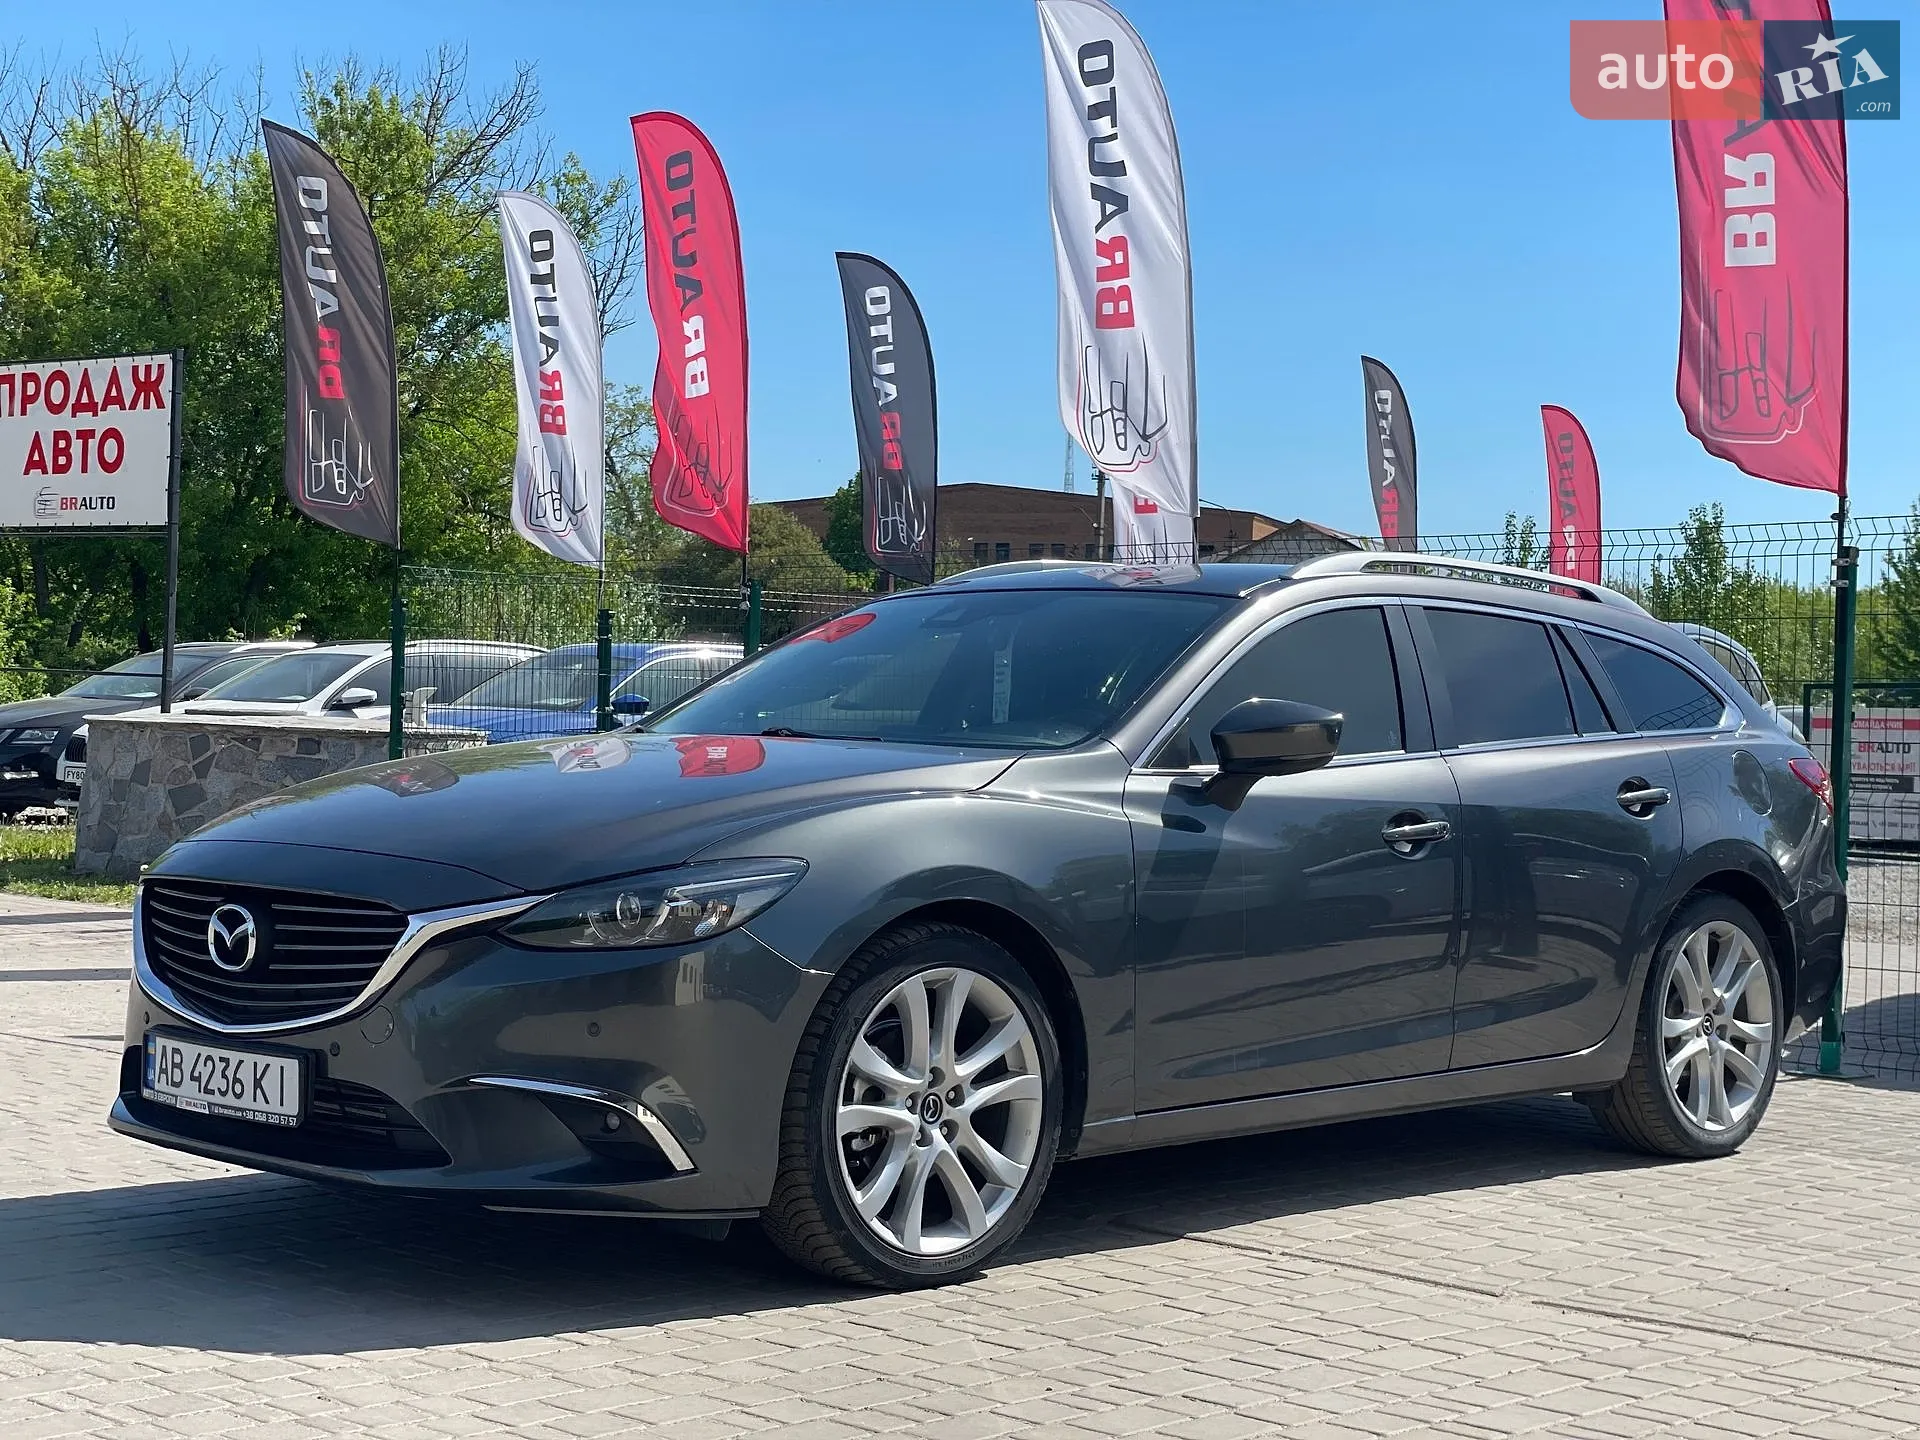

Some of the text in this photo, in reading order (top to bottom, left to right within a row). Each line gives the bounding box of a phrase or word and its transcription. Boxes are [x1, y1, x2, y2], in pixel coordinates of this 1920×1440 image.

[0, 364, 166, 418] ПРОДАЖ
[23, 427, 125, 475] АВТО
[60, 496, 116, 511] BRAUTO
[66, 770, 85, 780] FY80
[157, 1045, 184, 1089] AB
[190, 1052, 245, 1100] 4236
